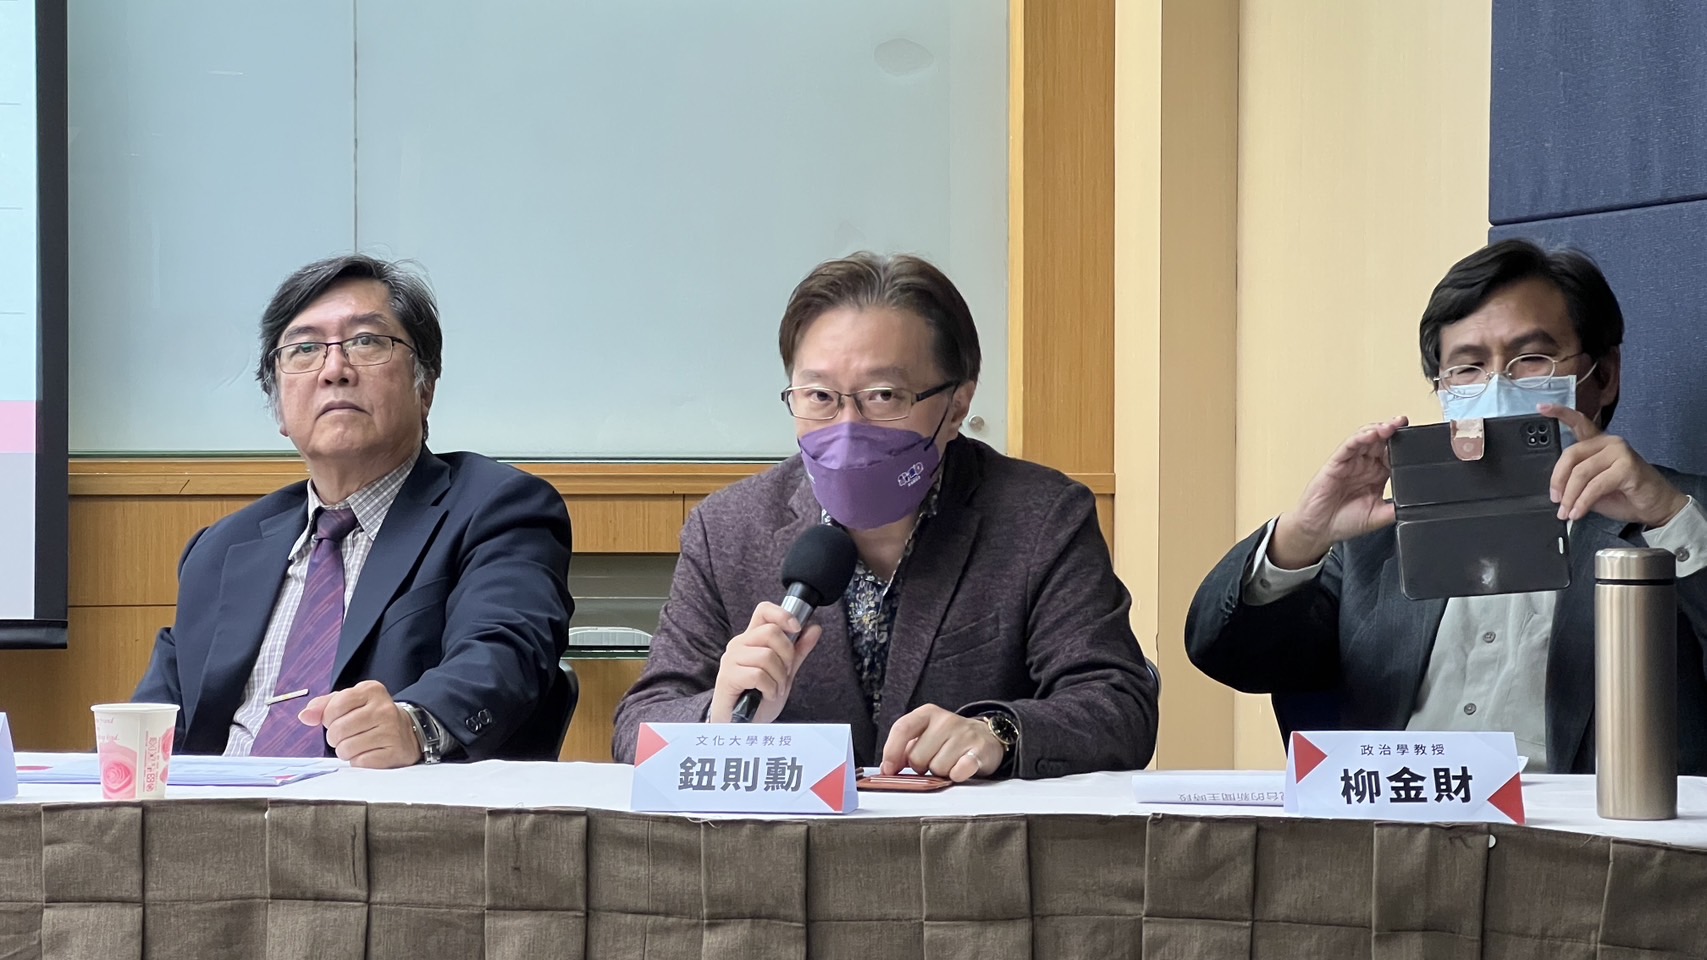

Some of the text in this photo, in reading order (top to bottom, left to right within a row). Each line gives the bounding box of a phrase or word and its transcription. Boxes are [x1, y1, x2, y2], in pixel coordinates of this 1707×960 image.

[696, 735, 792, 746] 文化大學教授
[1361, 743, 1445, 756] 政治學教授
[1341, 766, 1473, 805] 柳金財
